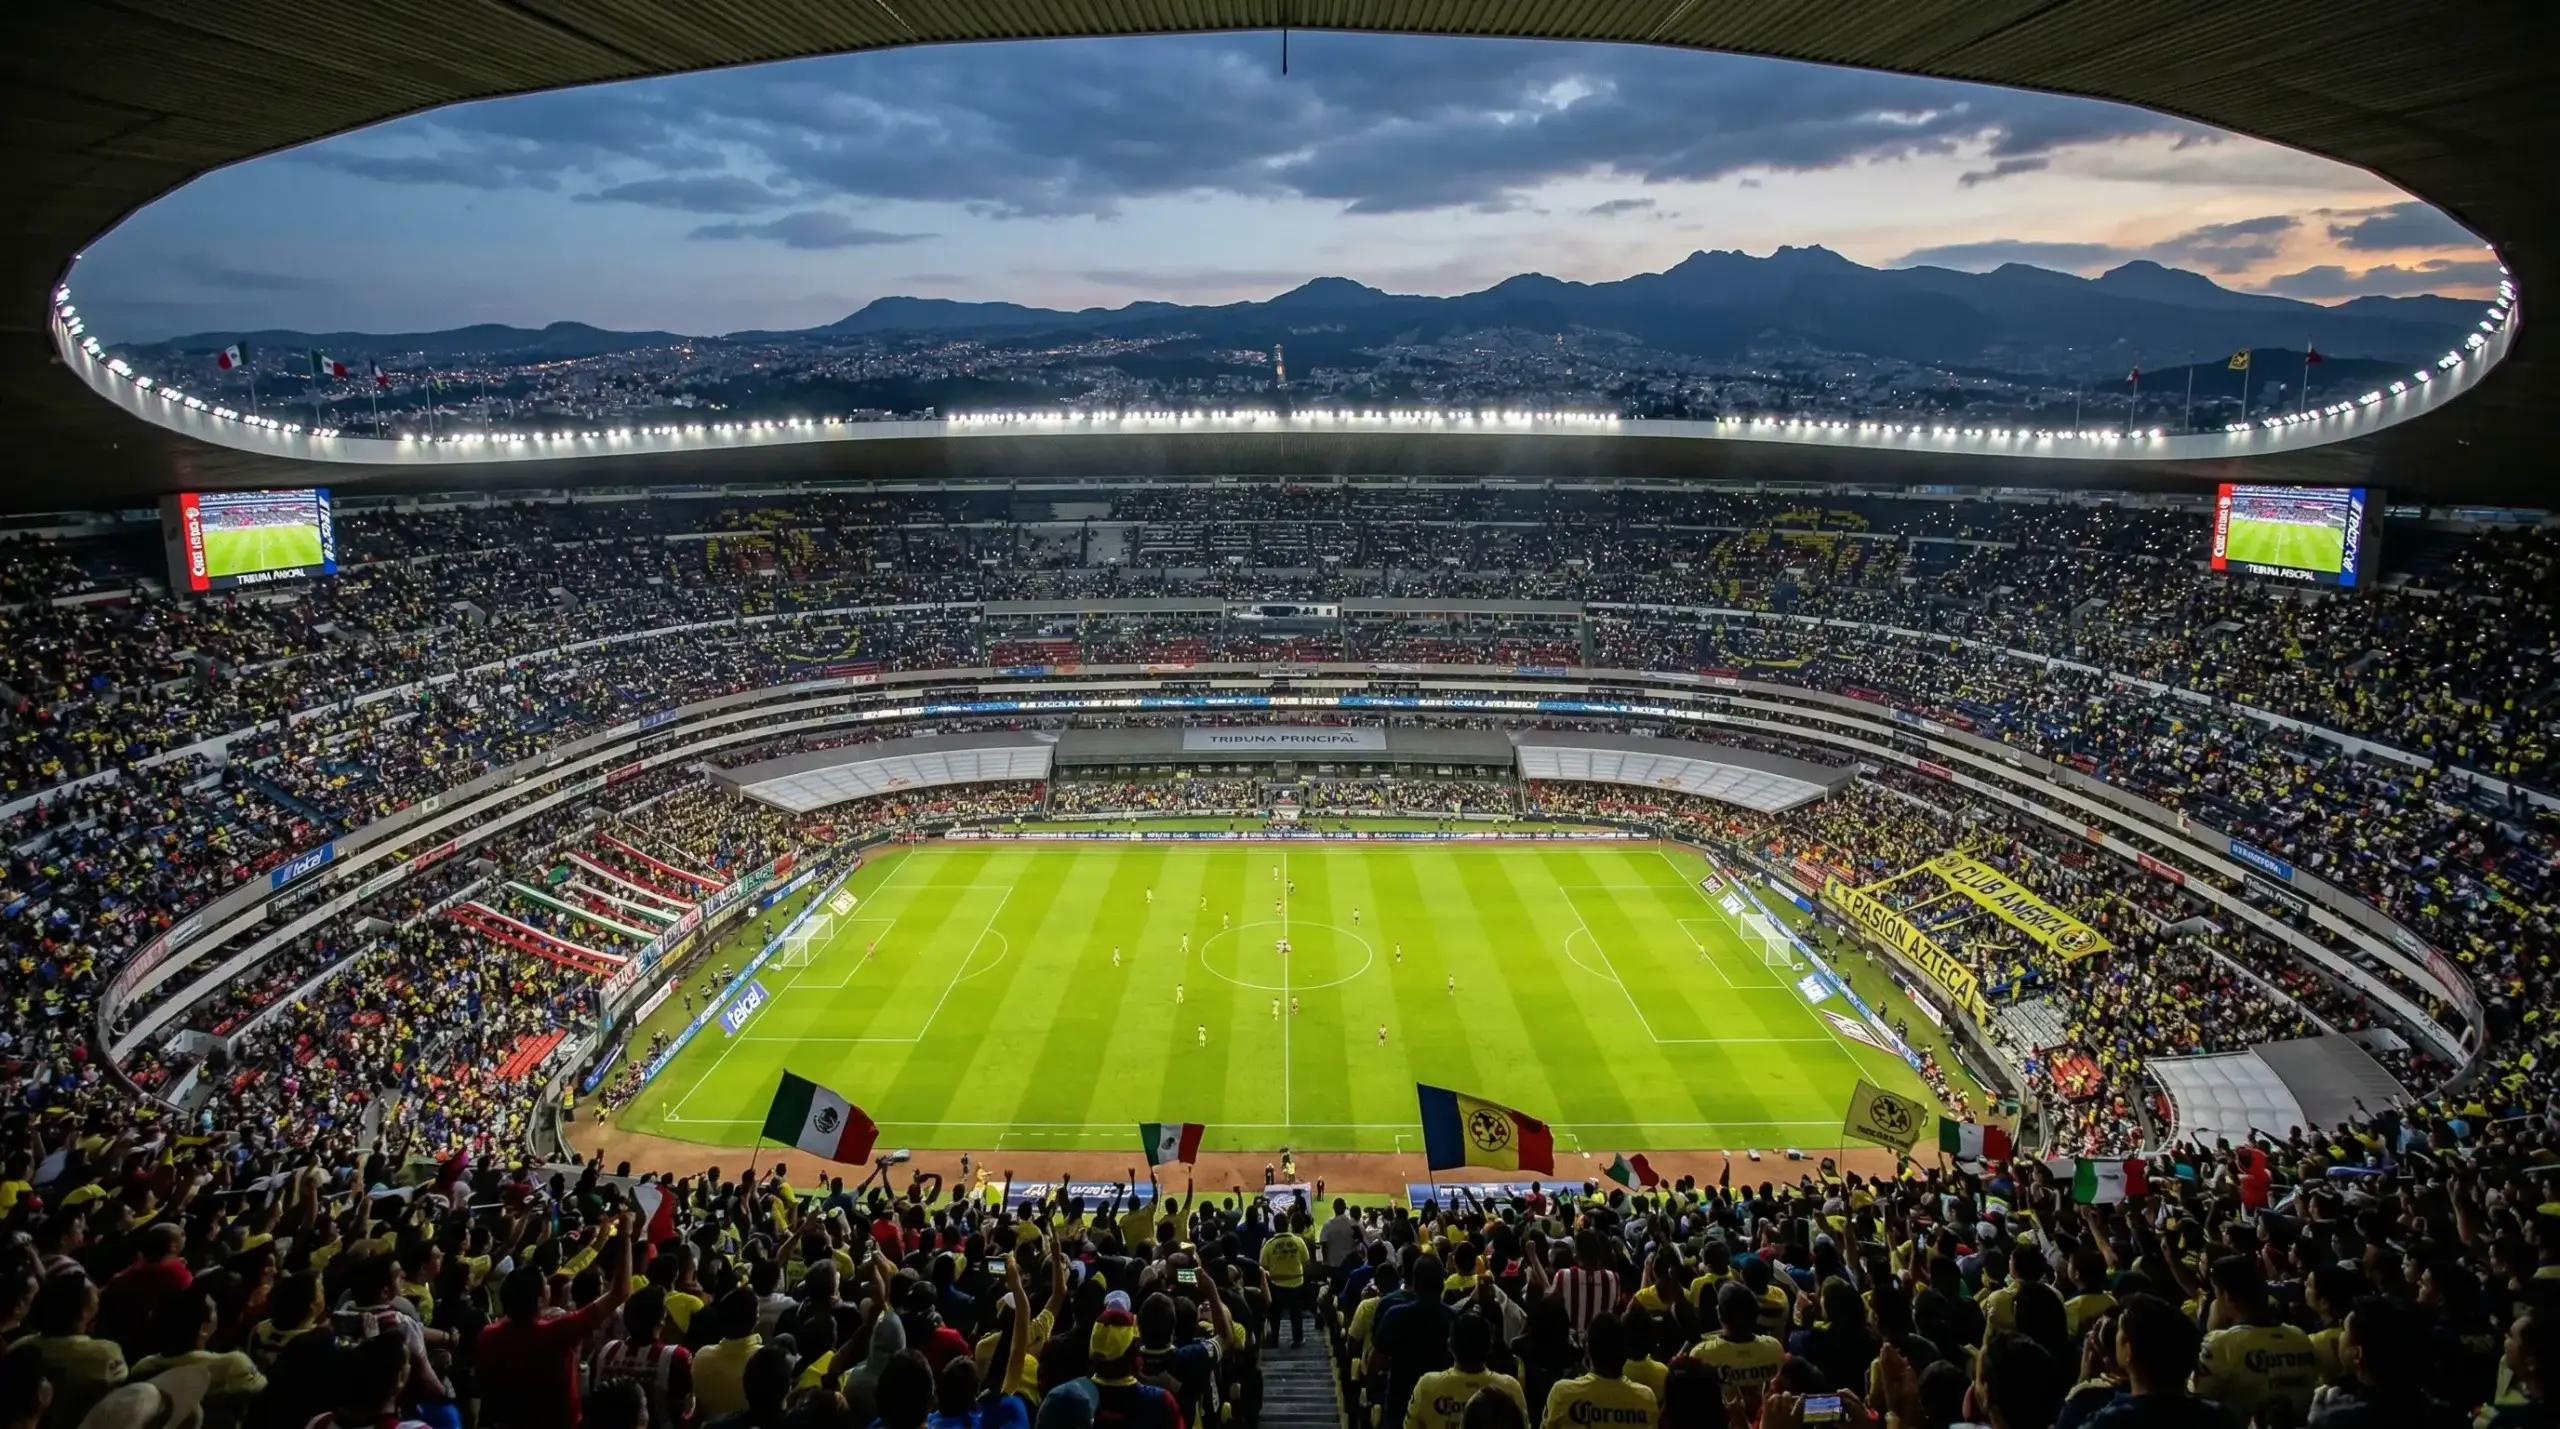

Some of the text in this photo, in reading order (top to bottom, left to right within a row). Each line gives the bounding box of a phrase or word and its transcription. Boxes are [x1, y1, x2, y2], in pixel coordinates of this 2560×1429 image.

[1210, 734, 1360, 744] TRIBUNA PRINCIPAL
[1950, 865, 2007, 895] CLUB
[1908, 935, 1971, 1001] AZTECA
[1569, 1399, 1648, 1428] Corona
